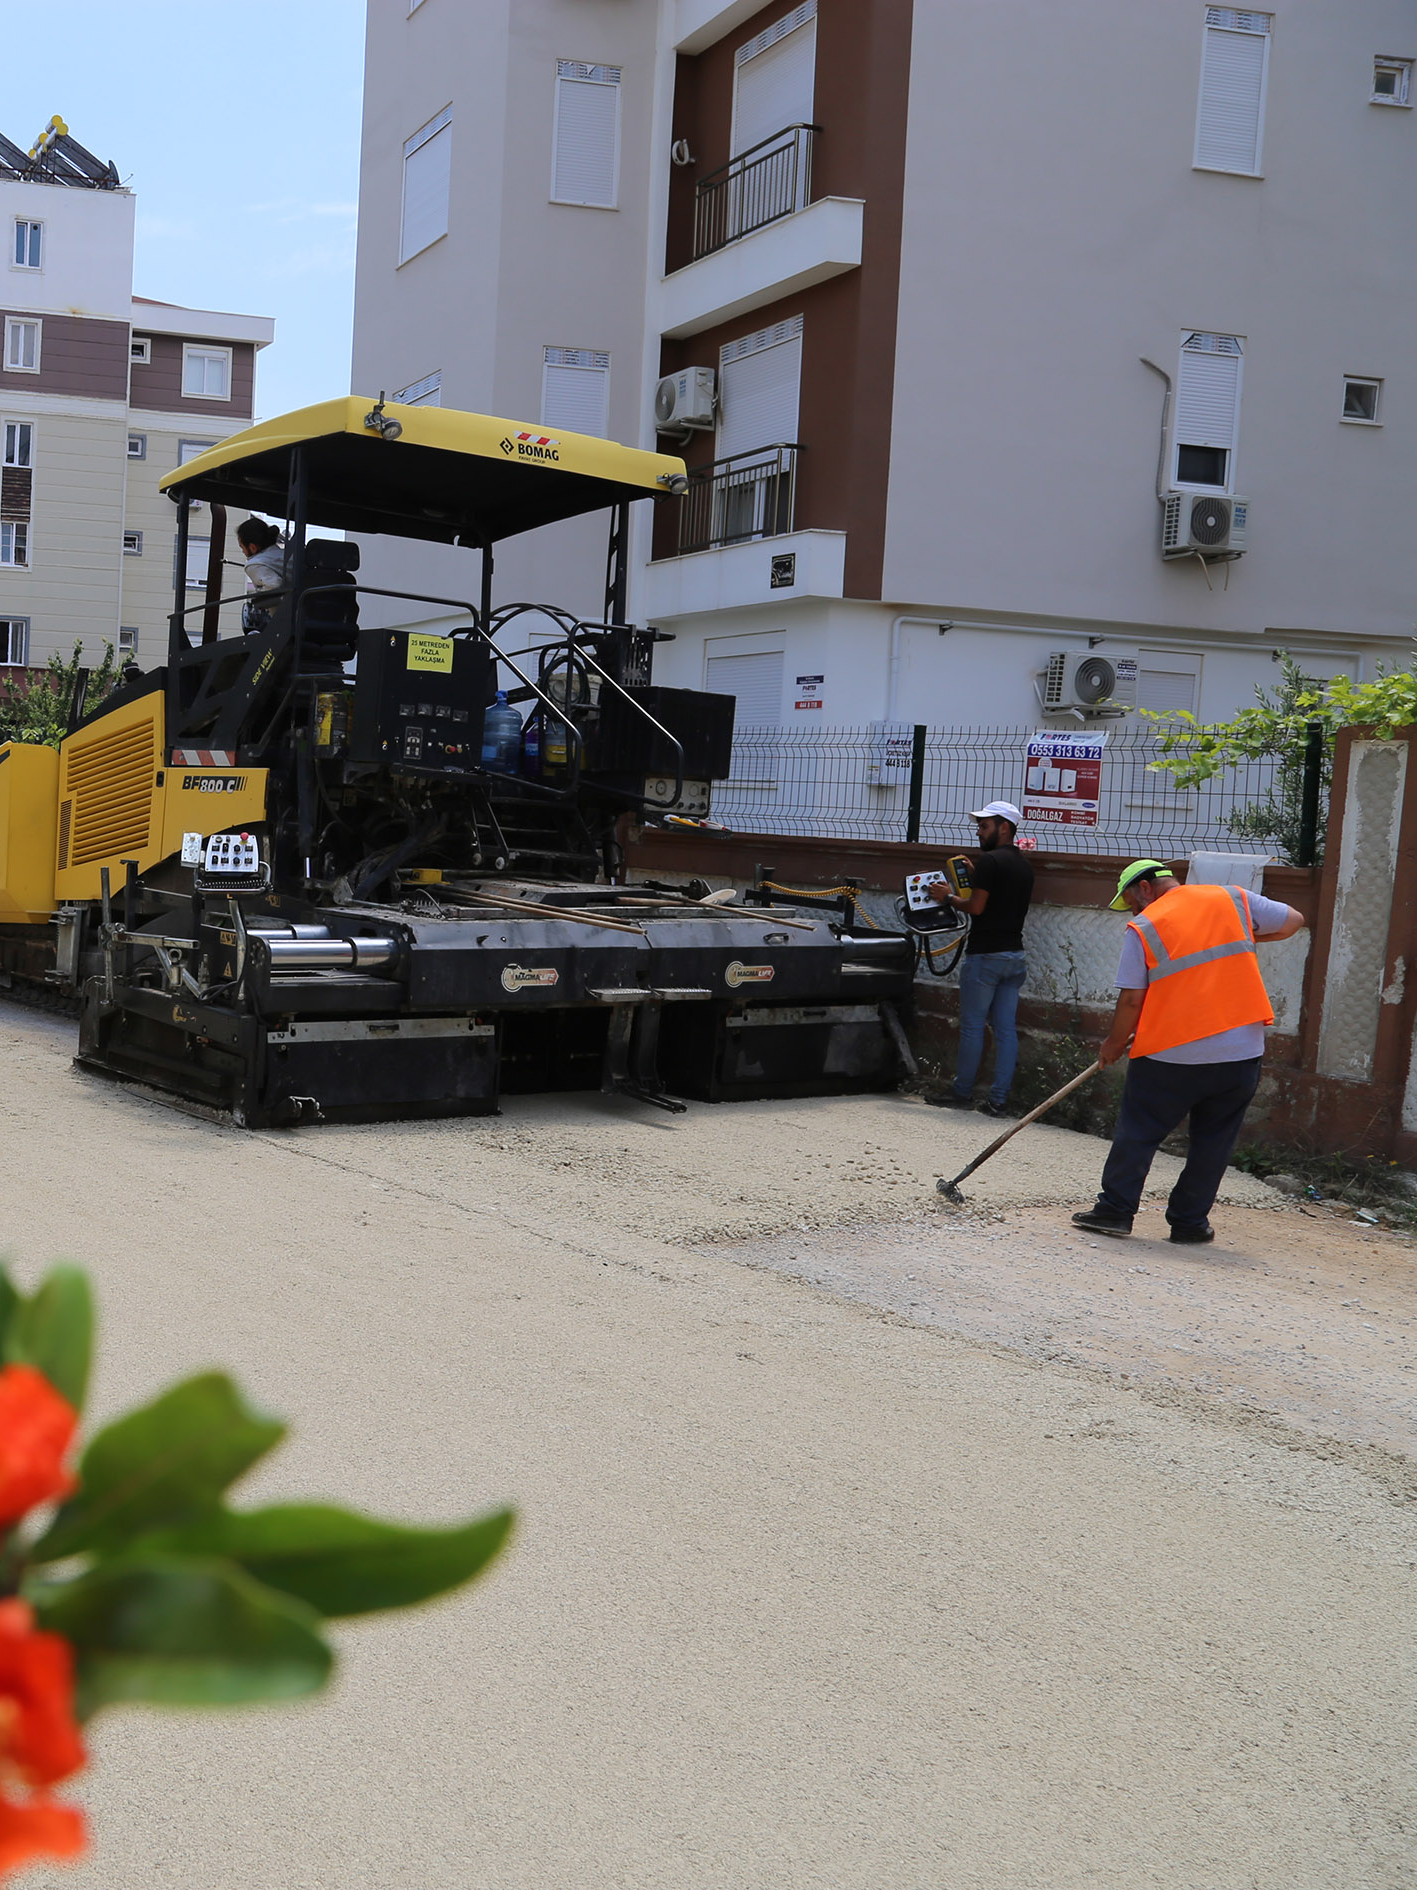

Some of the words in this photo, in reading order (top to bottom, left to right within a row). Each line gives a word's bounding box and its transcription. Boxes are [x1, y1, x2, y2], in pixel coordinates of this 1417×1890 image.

[518, 443, 559, 461] BOMAG
[419, 640, 450, 649] METREDEN
[421, 648, 439, 656] FAZLA
[414, 655, 445, 664] YAKLAŞMA
[1031, 744, 1054, 756] 0553
[1055, 745, 1072, 757] 313
[1074, 746, 1086, 758] 63
[1088, 747, 1100, 759] 72
[1027, 808, 1063, 822] DOĞALGAZ
